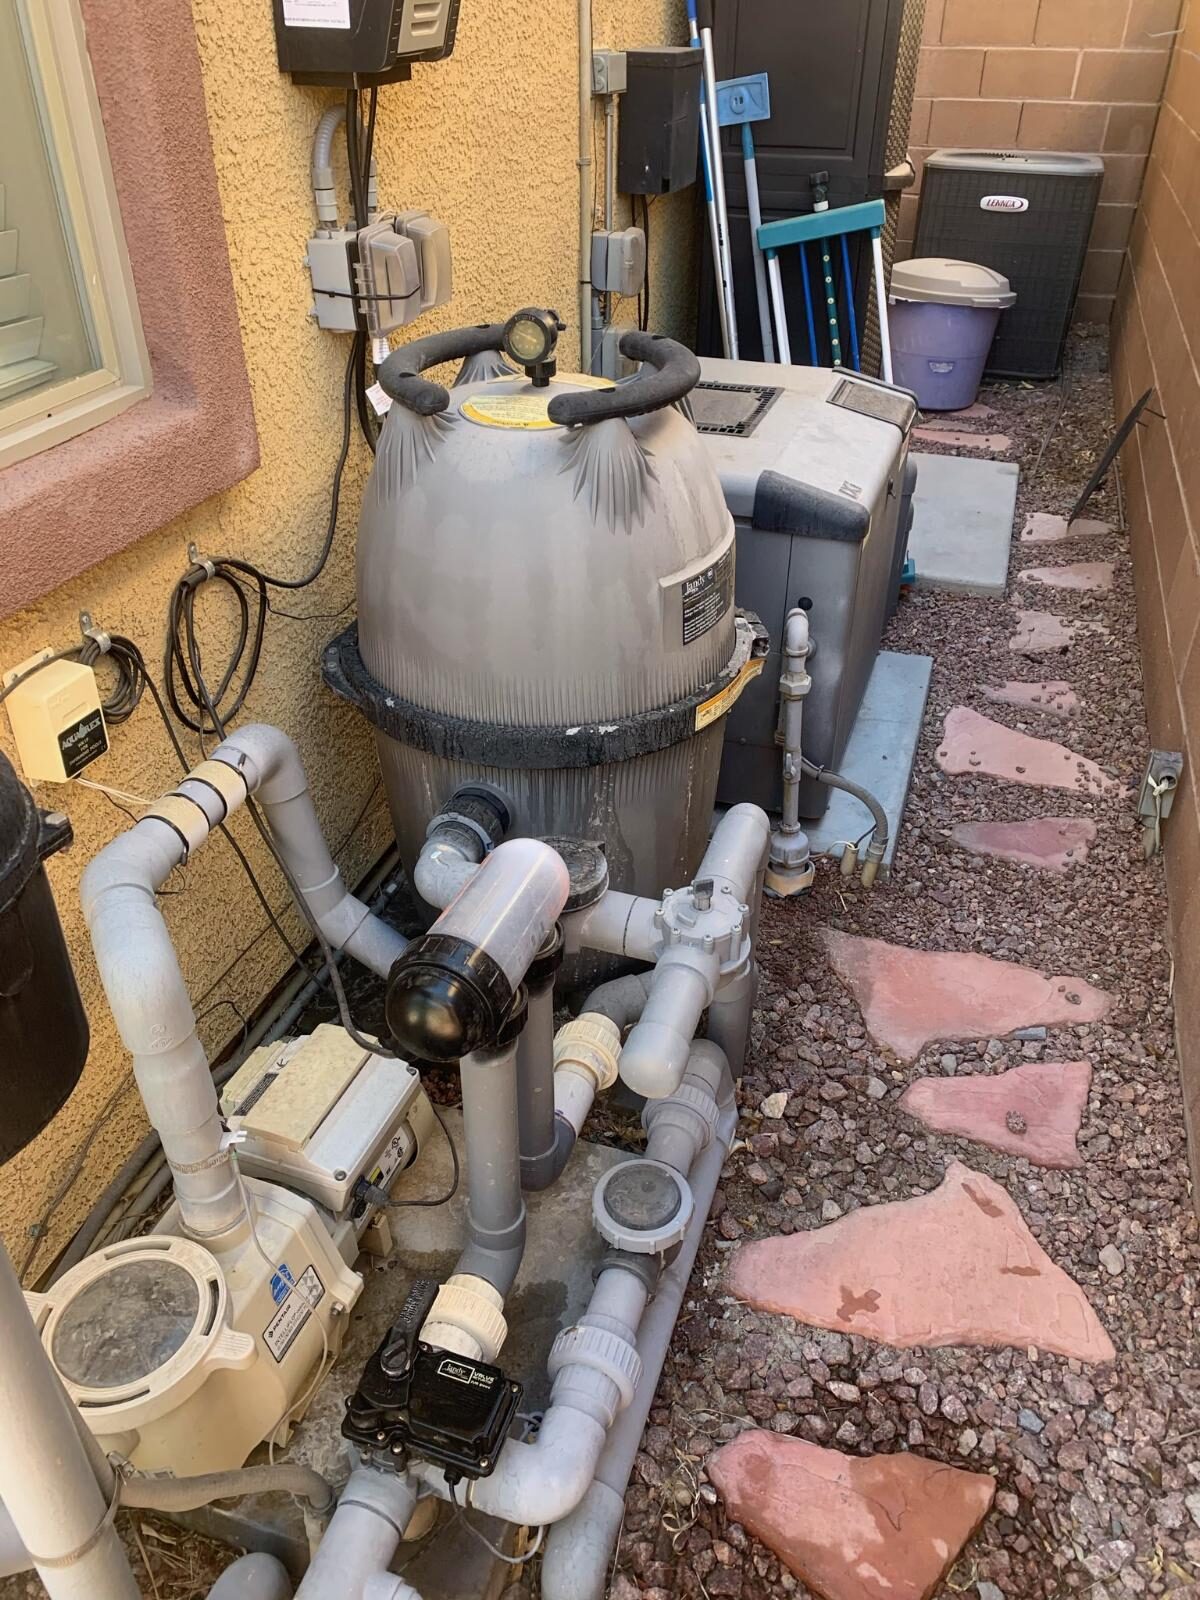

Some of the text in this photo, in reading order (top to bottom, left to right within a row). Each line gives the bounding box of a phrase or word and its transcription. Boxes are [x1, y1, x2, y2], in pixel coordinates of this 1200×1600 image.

[986, 199, 1017, 208] LENNOX
[686, 575, 705, 593] Jandy
[272, 1304, 290, 1331] PENTAIR
